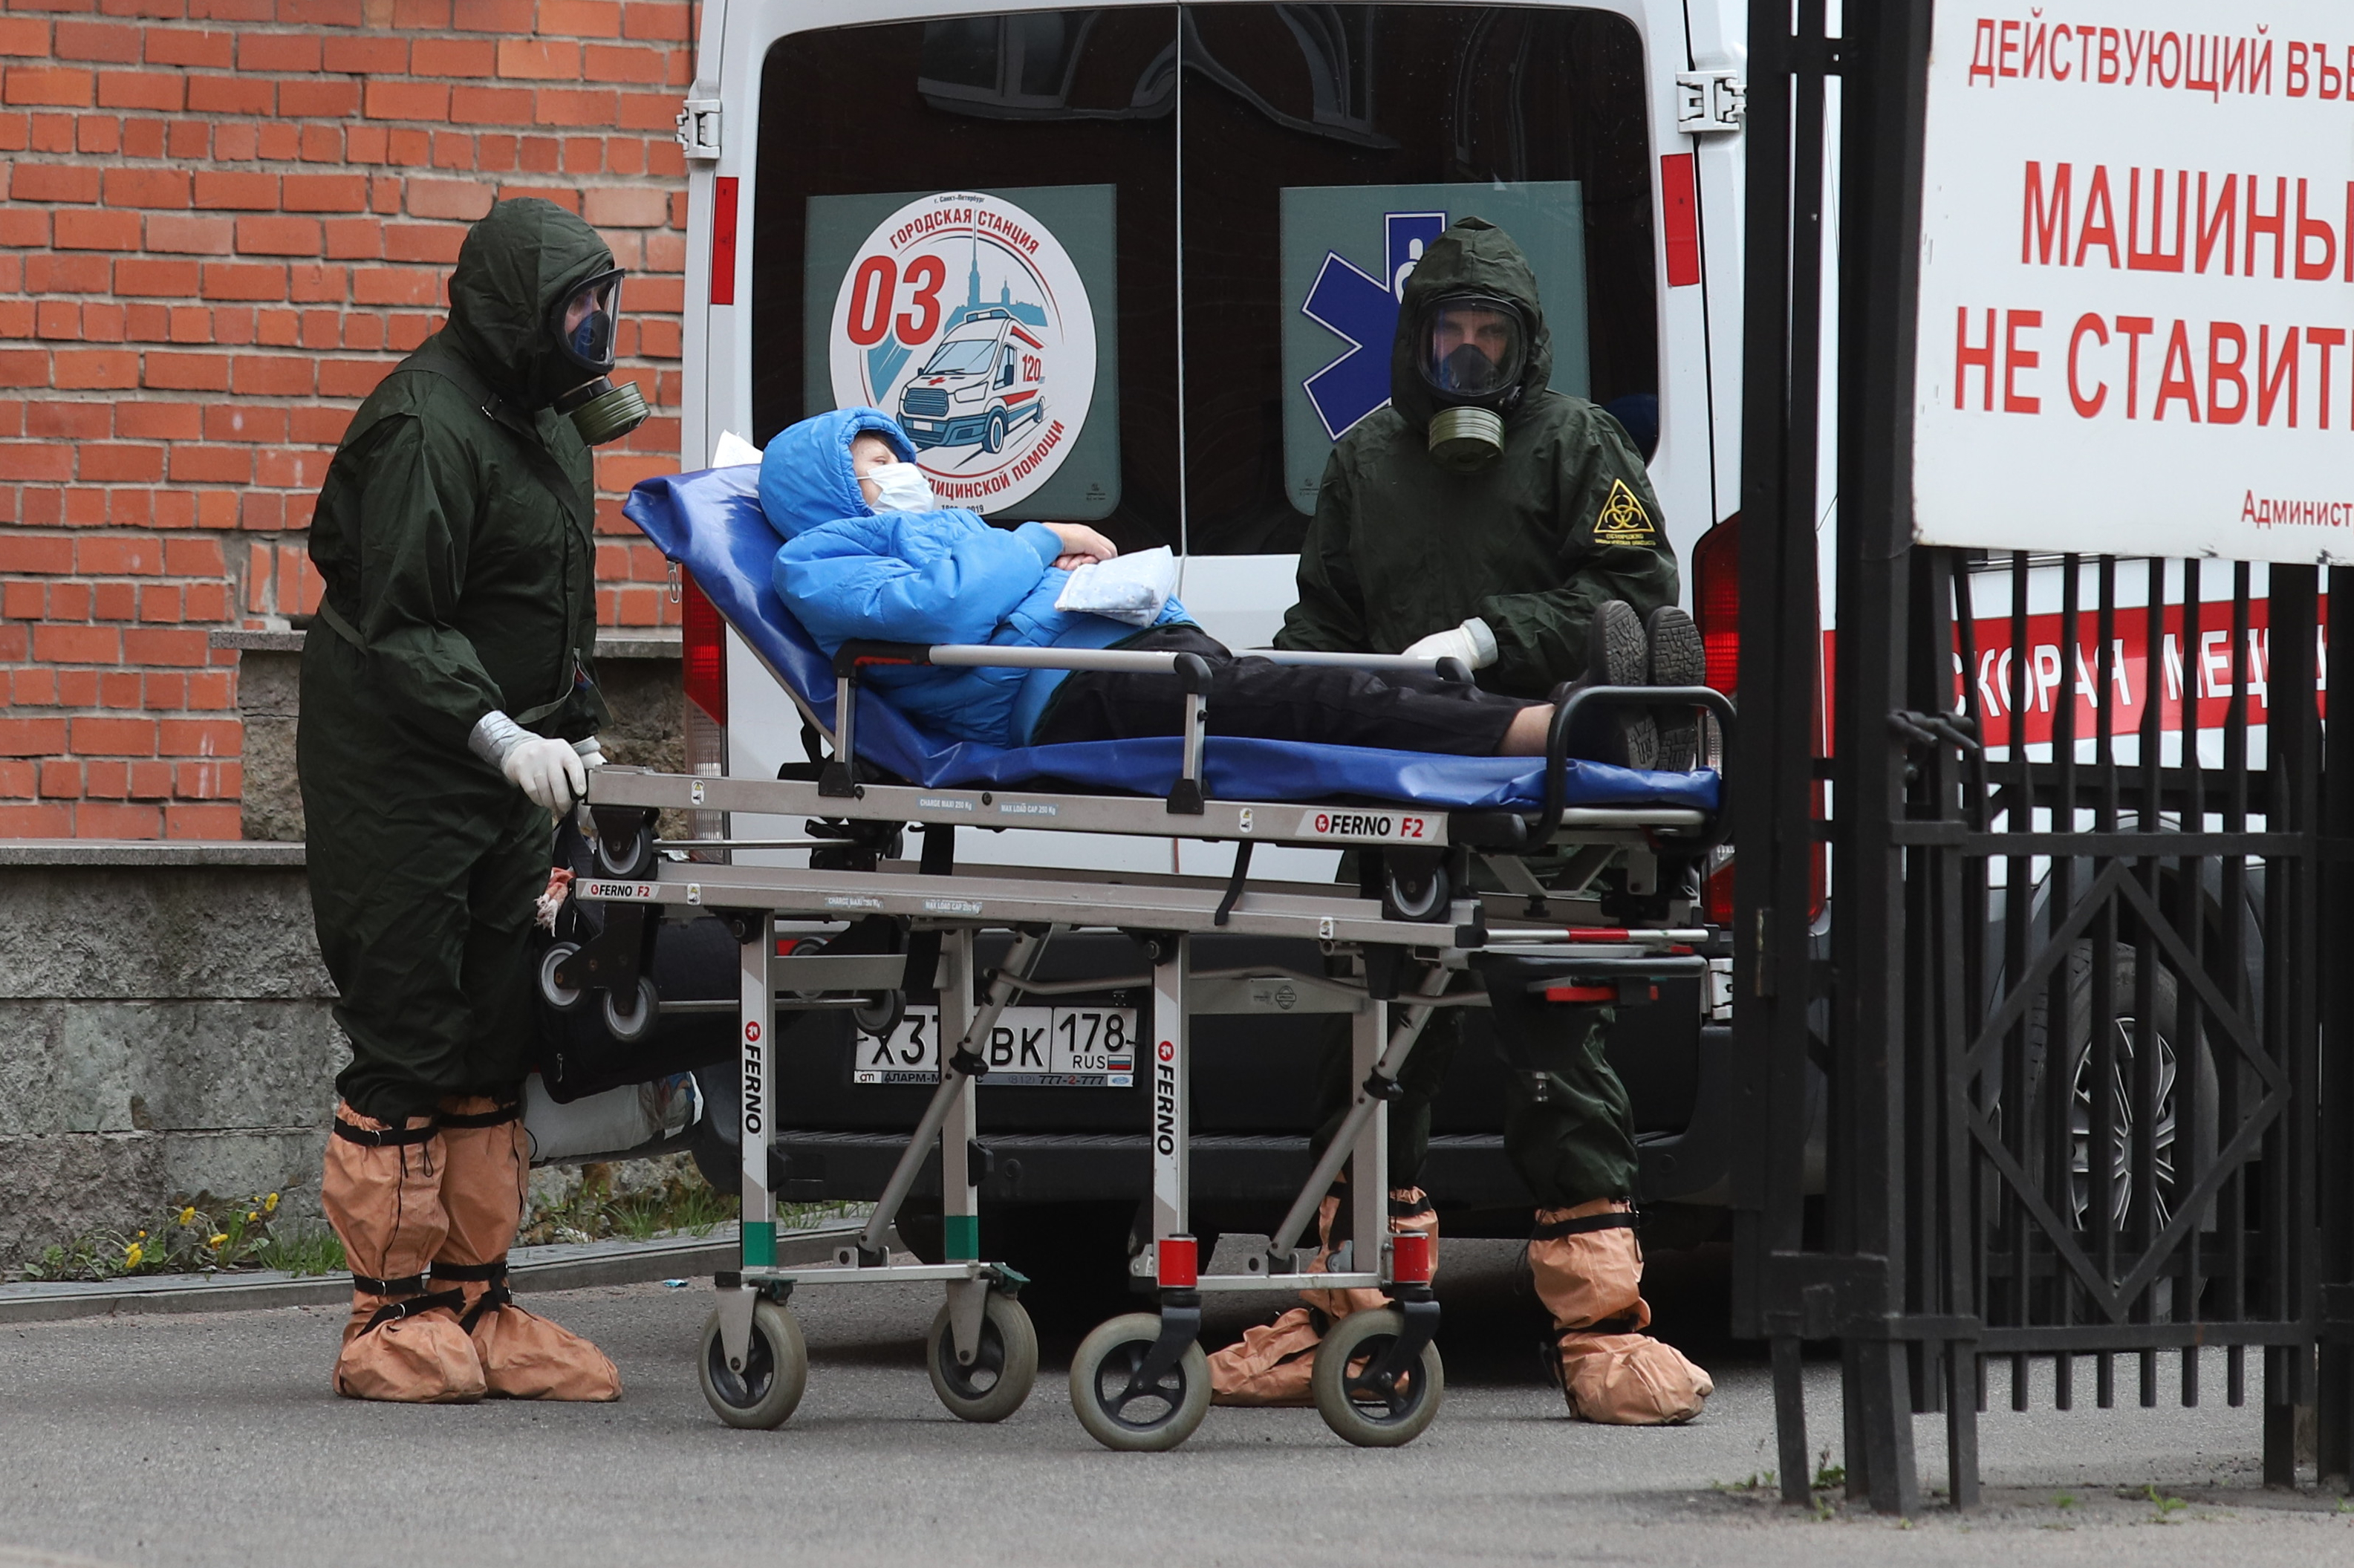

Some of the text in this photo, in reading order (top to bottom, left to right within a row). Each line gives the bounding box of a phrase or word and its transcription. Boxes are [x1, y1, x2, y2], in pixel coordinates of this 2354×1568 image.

[1968, 7, 2273, 104] ДЕЙСТВУЮЩИЙ
[888, 208, 1040, 255] ГОРОДСКАЯ СТАНЦИЯ
[2021, 160, 2354, 283] МАШИНЫ
[847, 255, 946, 345] 03
[1022, 353, 1041, 383] 120
[1954, 305, 2354, 432] НЕ СТАВИТ
[925, 420, 1064, 501] ДИЦИНСКОЙ ПОМОЩИ
[2241, 489, 2354, 535] Админист
[1330, 814, 1425, 838] FERNO F2
[599, 885, 651, 897] FERNO F2
[1059, 1013, 1125, 1053] 178
[1039, 1076, 1105, 1084] 777-2-777
[1073, 1055, 1106, 1070] RUS
[744, 1044, 761, 1134] FERNO
[1157, 1064, 1174, 1156] FERNO
